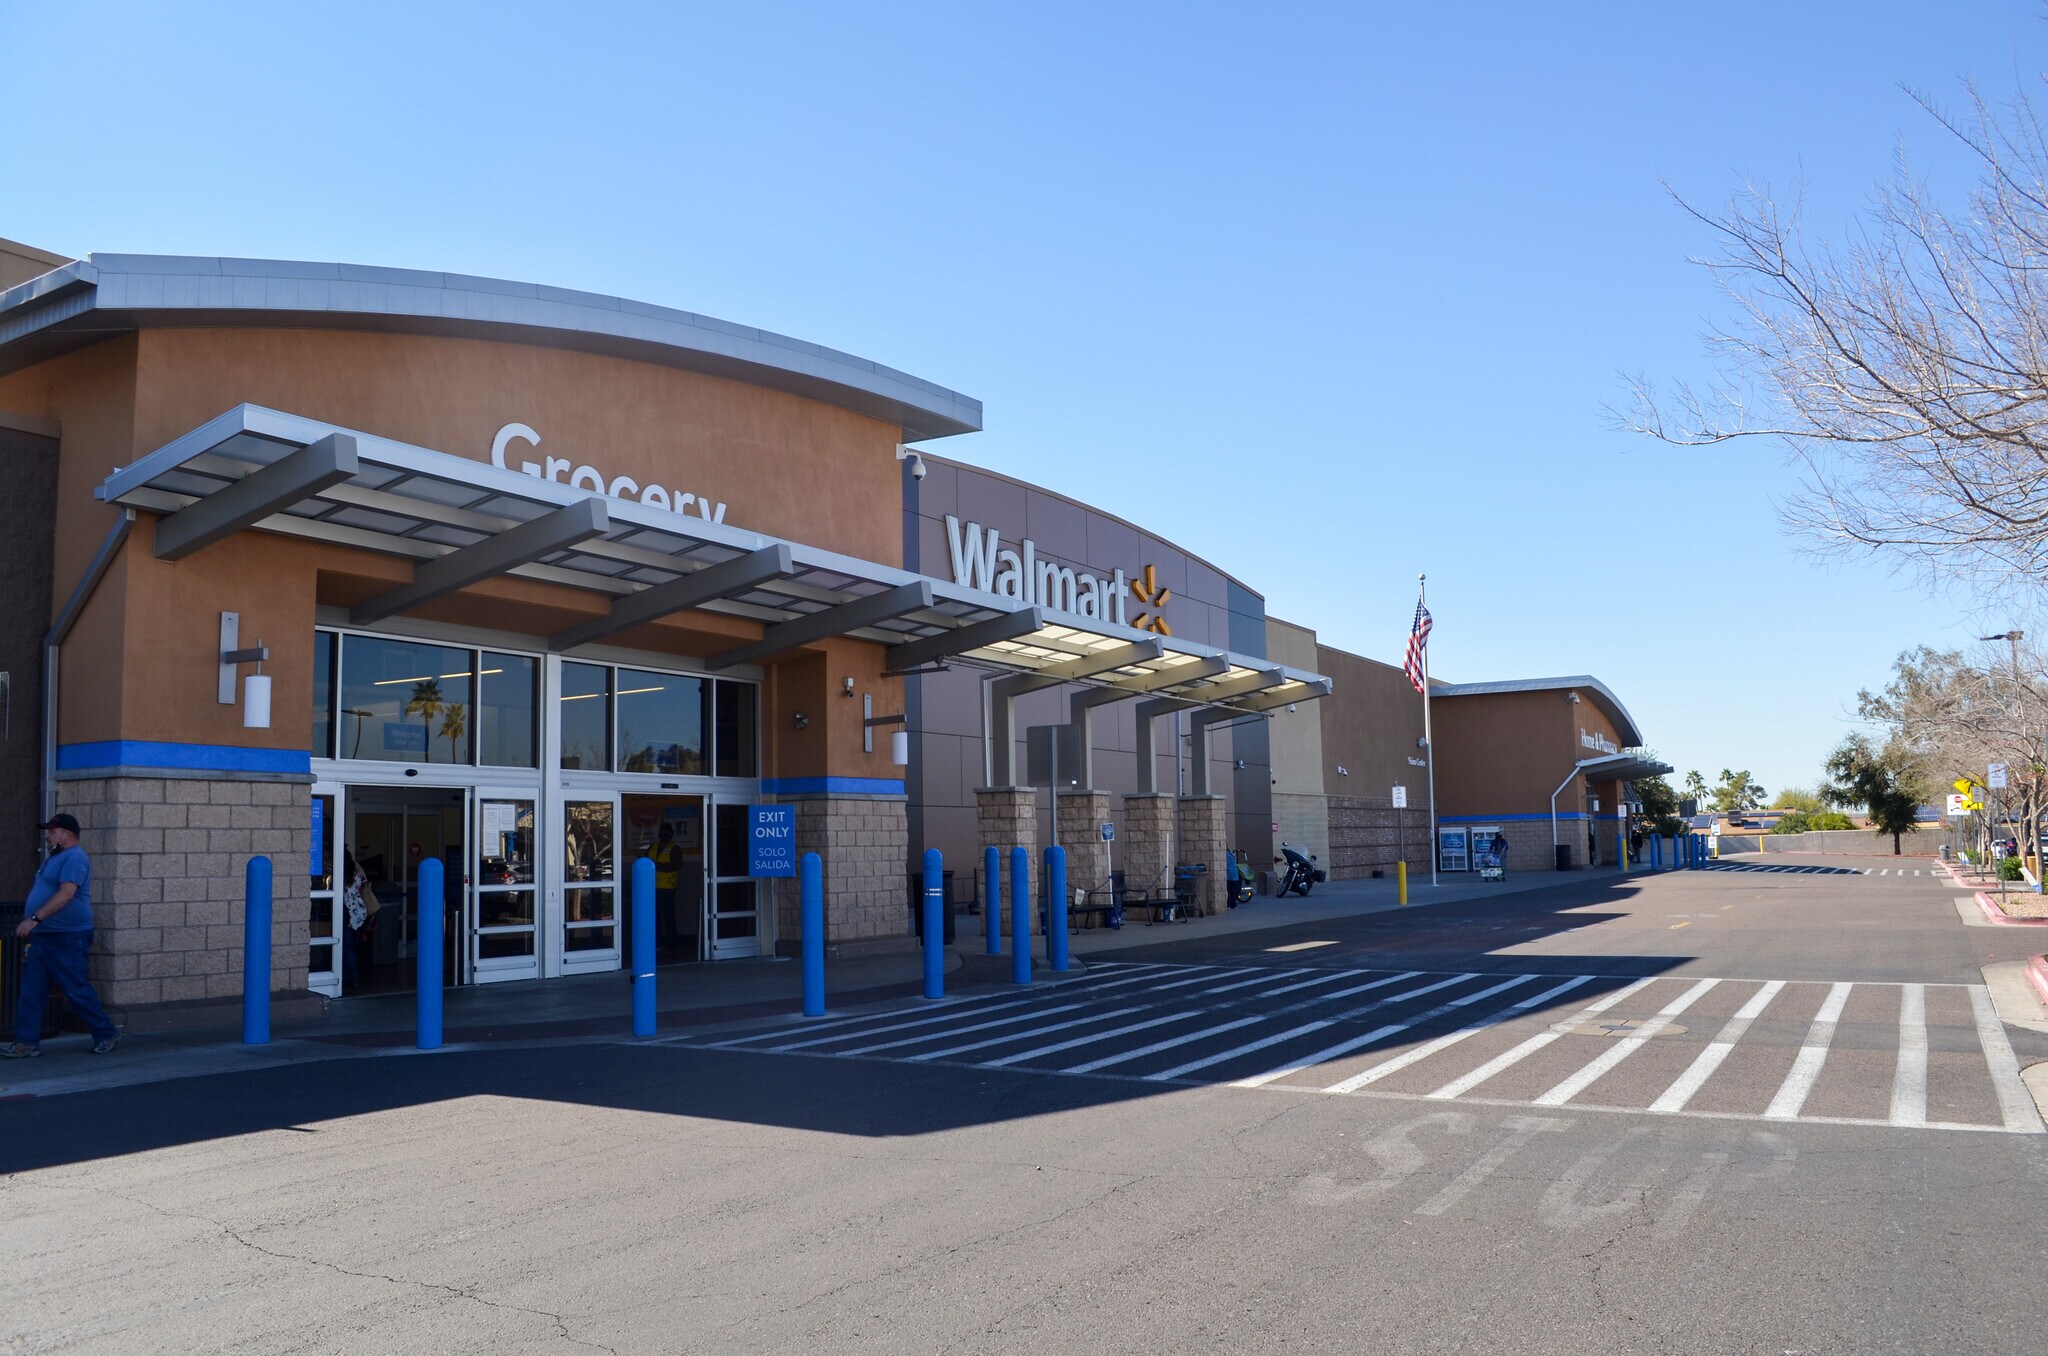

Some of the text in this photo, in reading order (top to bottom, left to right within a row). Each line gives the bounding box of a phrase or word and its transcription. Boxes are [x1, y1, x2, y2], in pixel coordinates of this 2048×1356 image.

[491, 422, 727, 525] Grocery
[945, 514, 1130, 627] Walmart
[759, 812, 785, 822] EXIT
[755, 827, 790, 838] ONLY
[758, 848, 786, 857] SOLO
[755, 860, 790, 869] SALIDA
